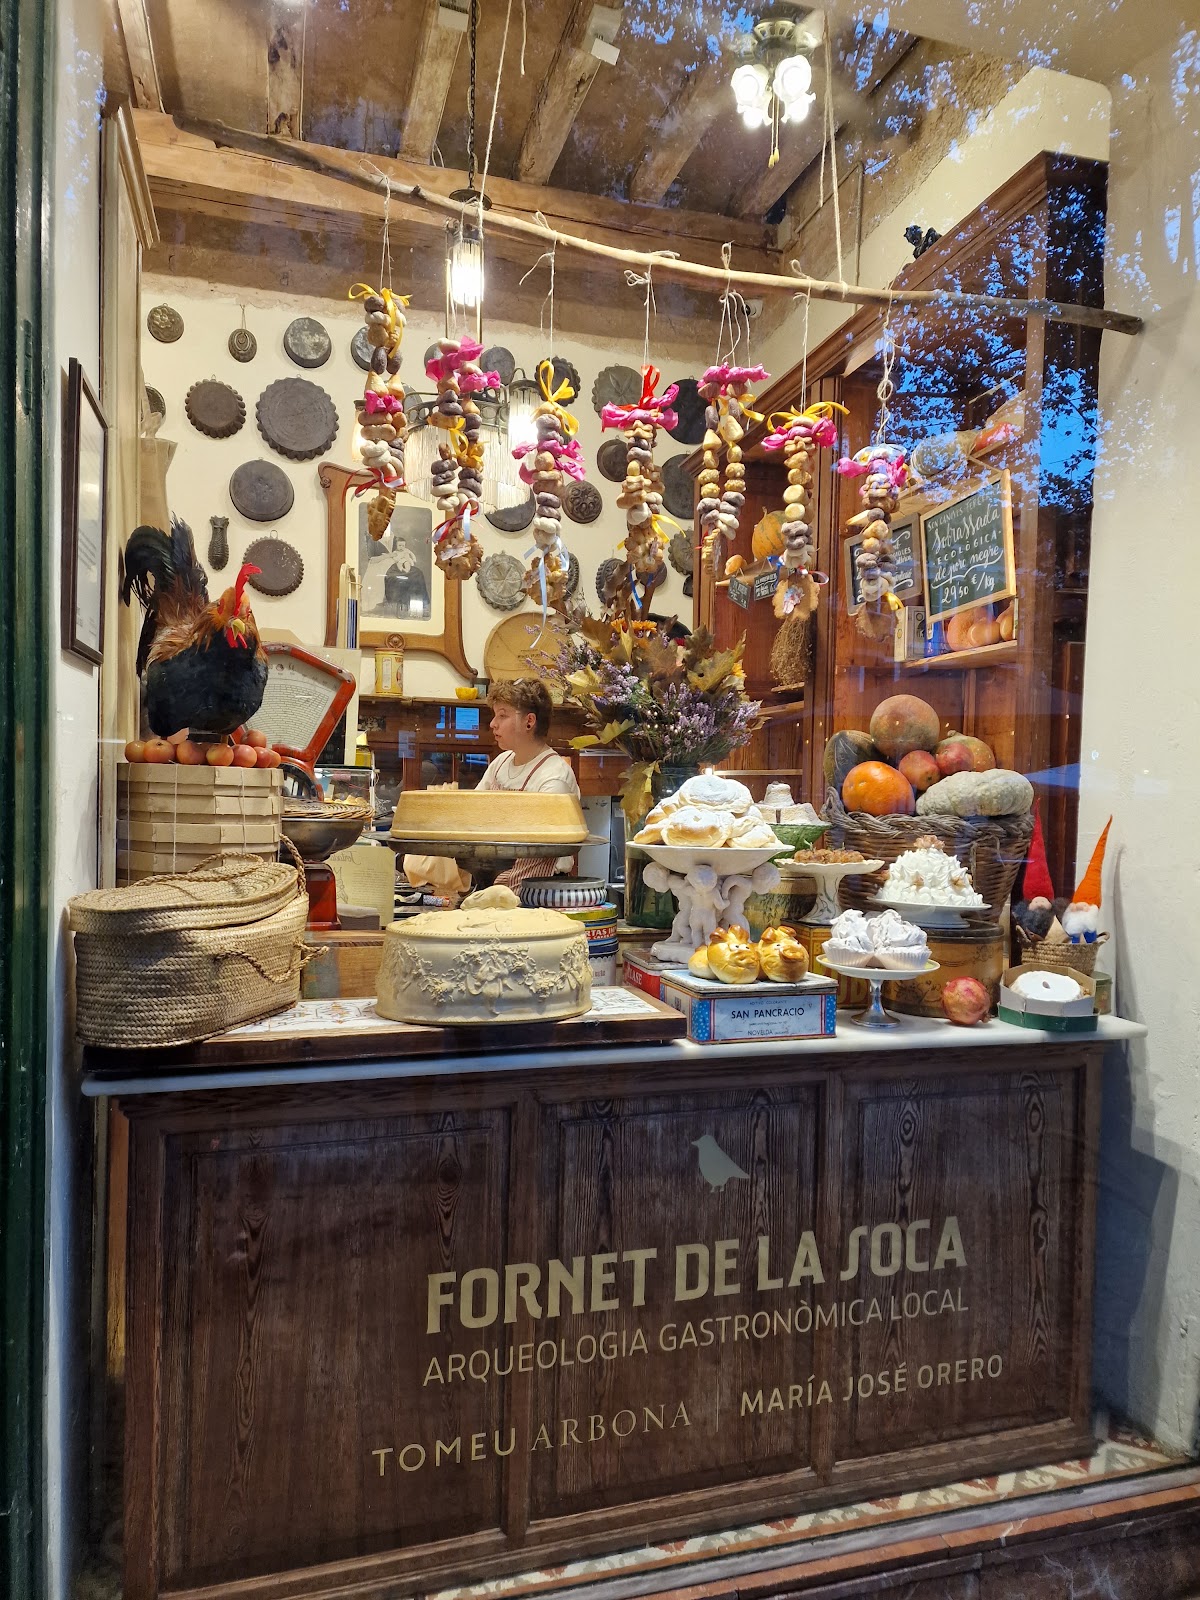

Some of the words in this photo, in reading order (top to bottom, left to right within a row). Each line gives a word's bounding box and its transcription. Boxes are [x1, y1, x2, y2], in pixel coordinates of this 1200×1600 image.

[934, 566, 946, 582] de
[970, 545, 999, 568] negre
[938, 530, 997, 564] ECOLÒGICA
[731, 1010, 750, 1019] SAN
[754, 1007, 805, 1018] PANCRACIO
[427, 1248, 657, 1334] FORNET
[673, 1238, 741, 1302] DE
[757, 1231, 826, 1290] LA
[841, 1216, 968, 1281] SOCA
[423, 1329, 648, 1387] ARQUEOLOGIA
[660, 1297, 883, 1351] GASTRONÒMICA
[891, 1287, 969, 1321] LOCAL
[372, 1428, 516, 1477] TOMEU
[531, 1401, 692, 1451] ARBONA
[741, 1375, 832, 1417] MARÍA
[843, 1361, 908, 1402] JOSÉ
[917, 1354, 1003, 1390] ORERO
